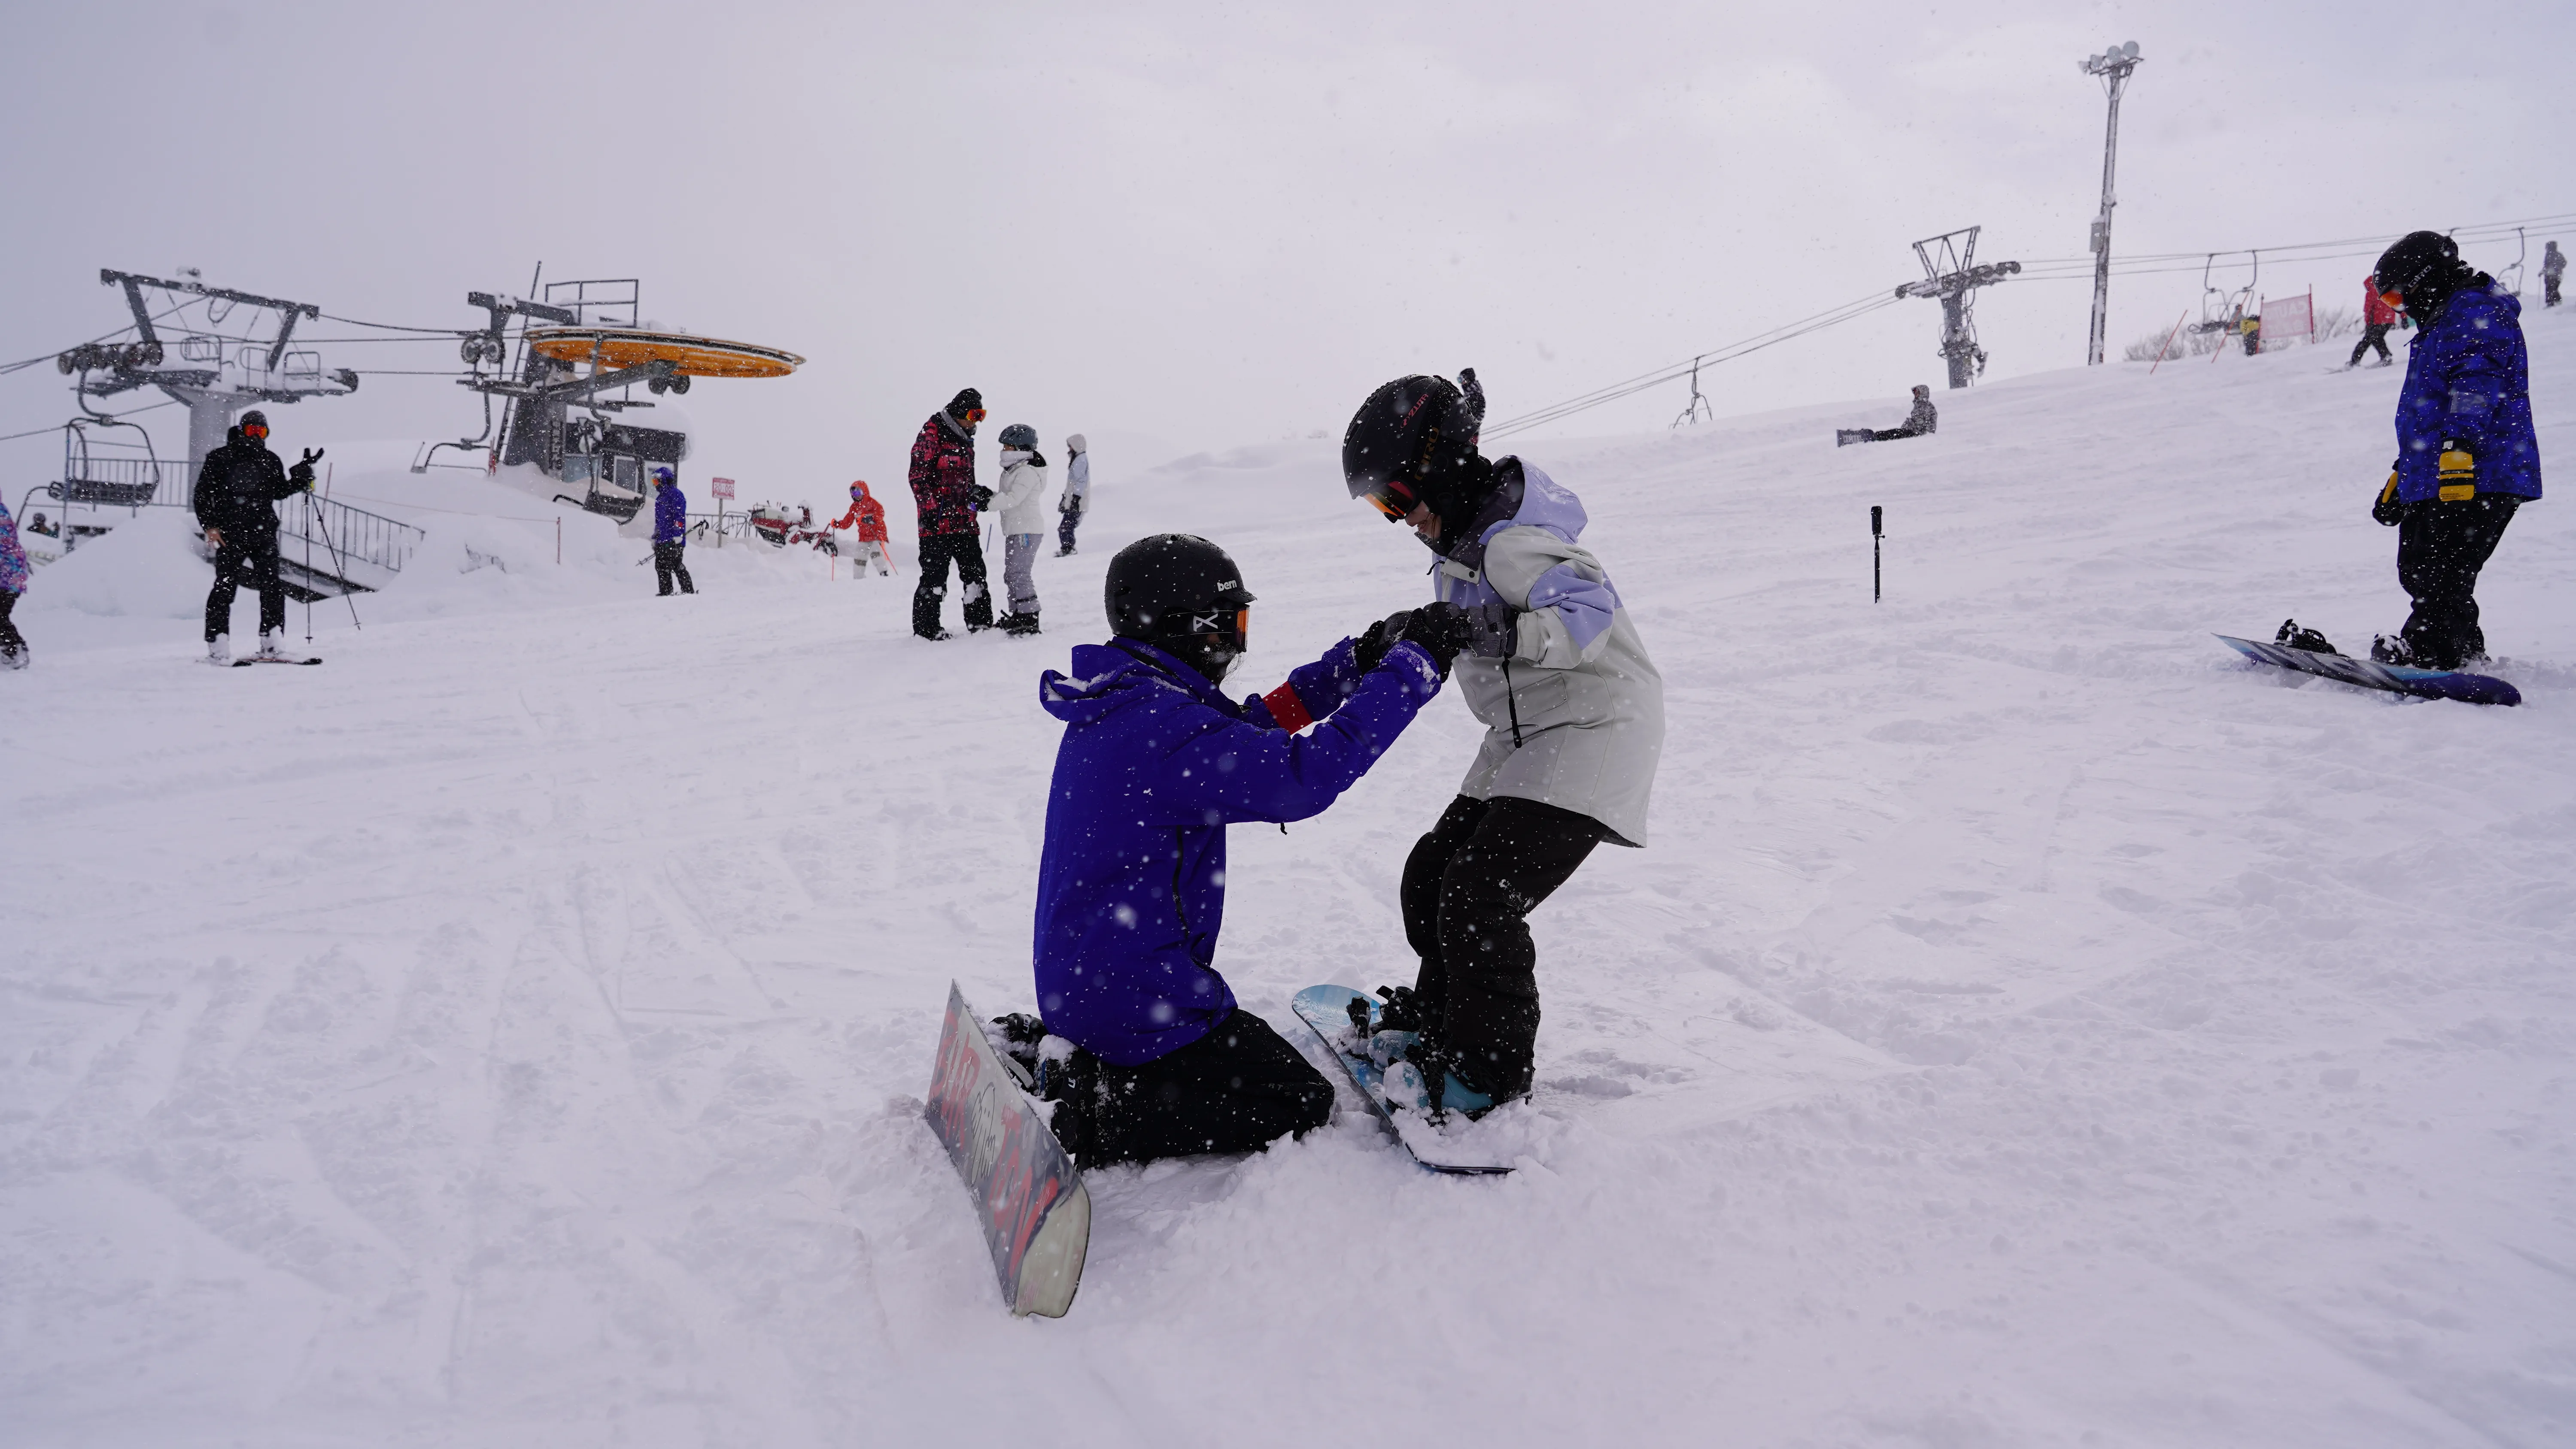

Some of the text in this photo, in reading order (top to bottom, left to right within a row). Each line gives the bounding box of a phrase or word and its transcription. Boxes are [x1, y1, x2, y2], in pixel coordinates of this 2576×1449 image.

[2408, 265, 2432, 288] GIRO
[1414, 427, 1440, 481] GIRO
[1217, 580, 1237, 591] bern
